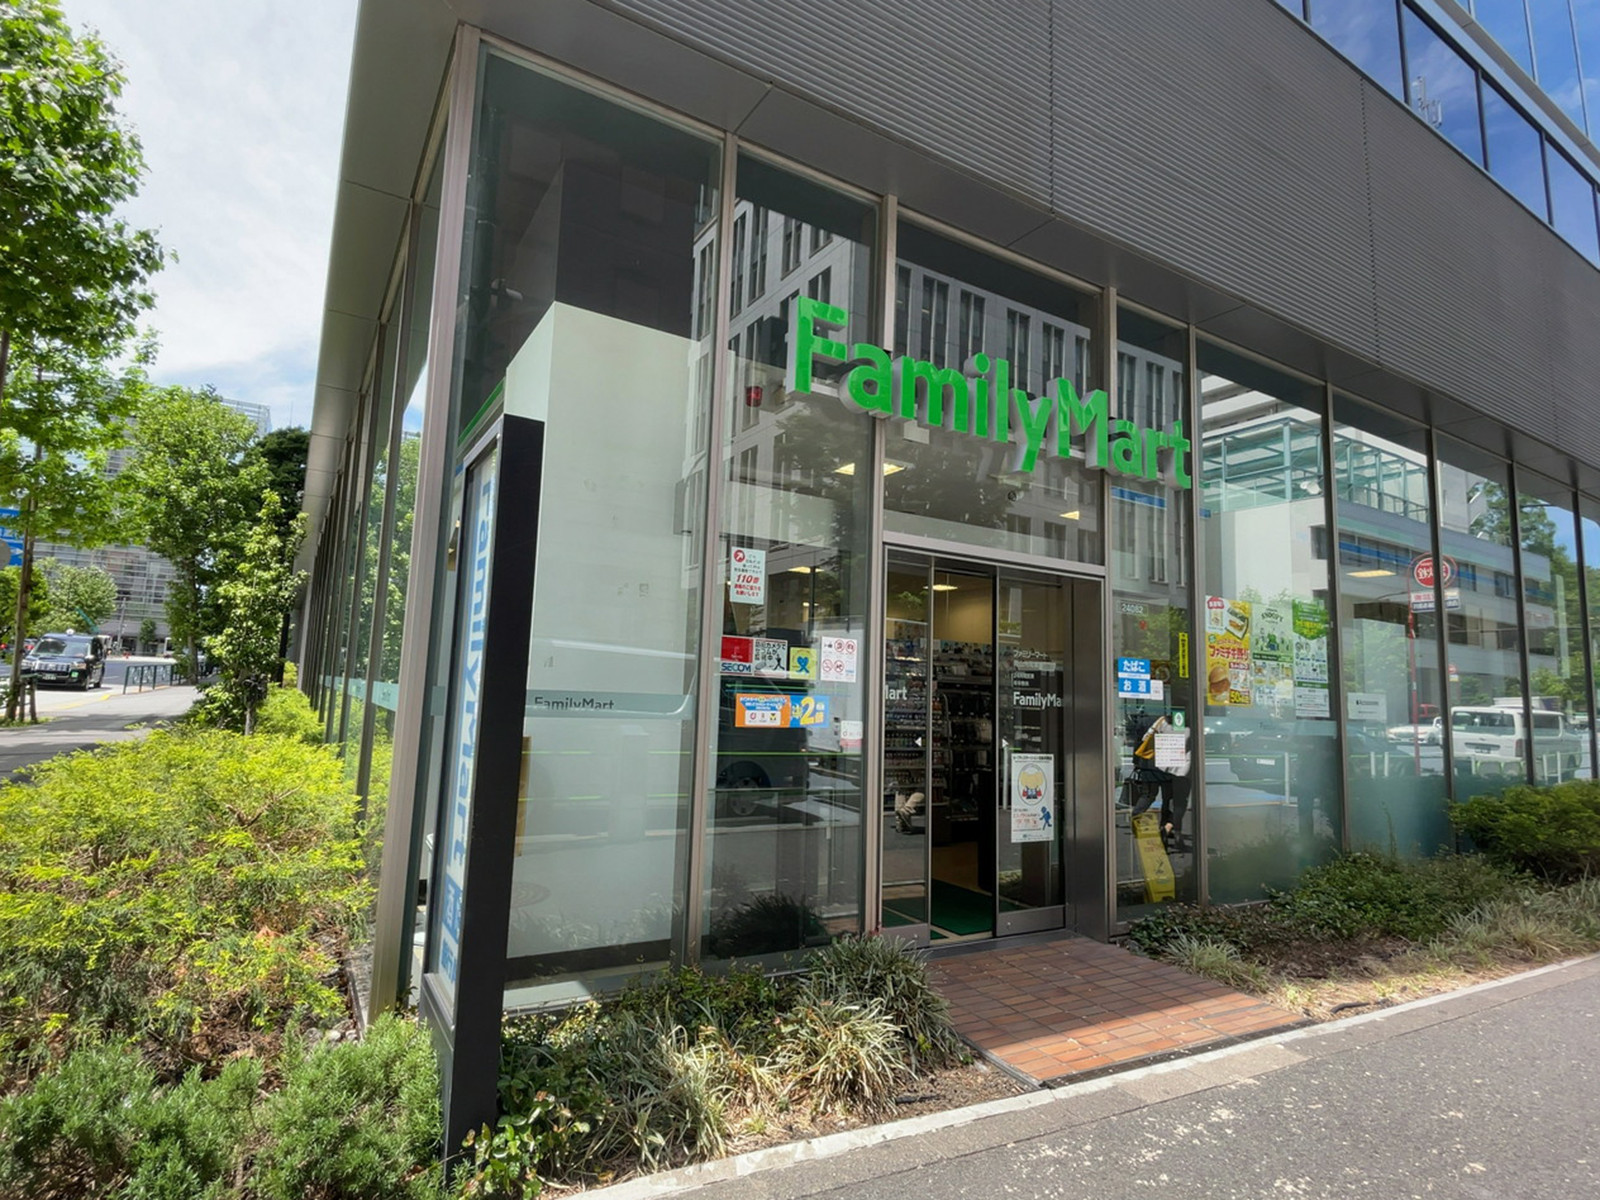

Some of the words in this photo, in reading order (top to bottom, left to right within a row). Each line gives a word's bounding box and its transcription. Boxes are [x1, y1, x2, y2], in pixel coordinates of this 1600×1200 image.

[785, 295, 1192, 490] FamilyMart
[721, 662, 752, 673] SECOM
[1122, 659, 1146, 672] たばこ
[534, 696, 614, 710] FamilyMart
[1013, 691, 1064, 710] FamilyMa
